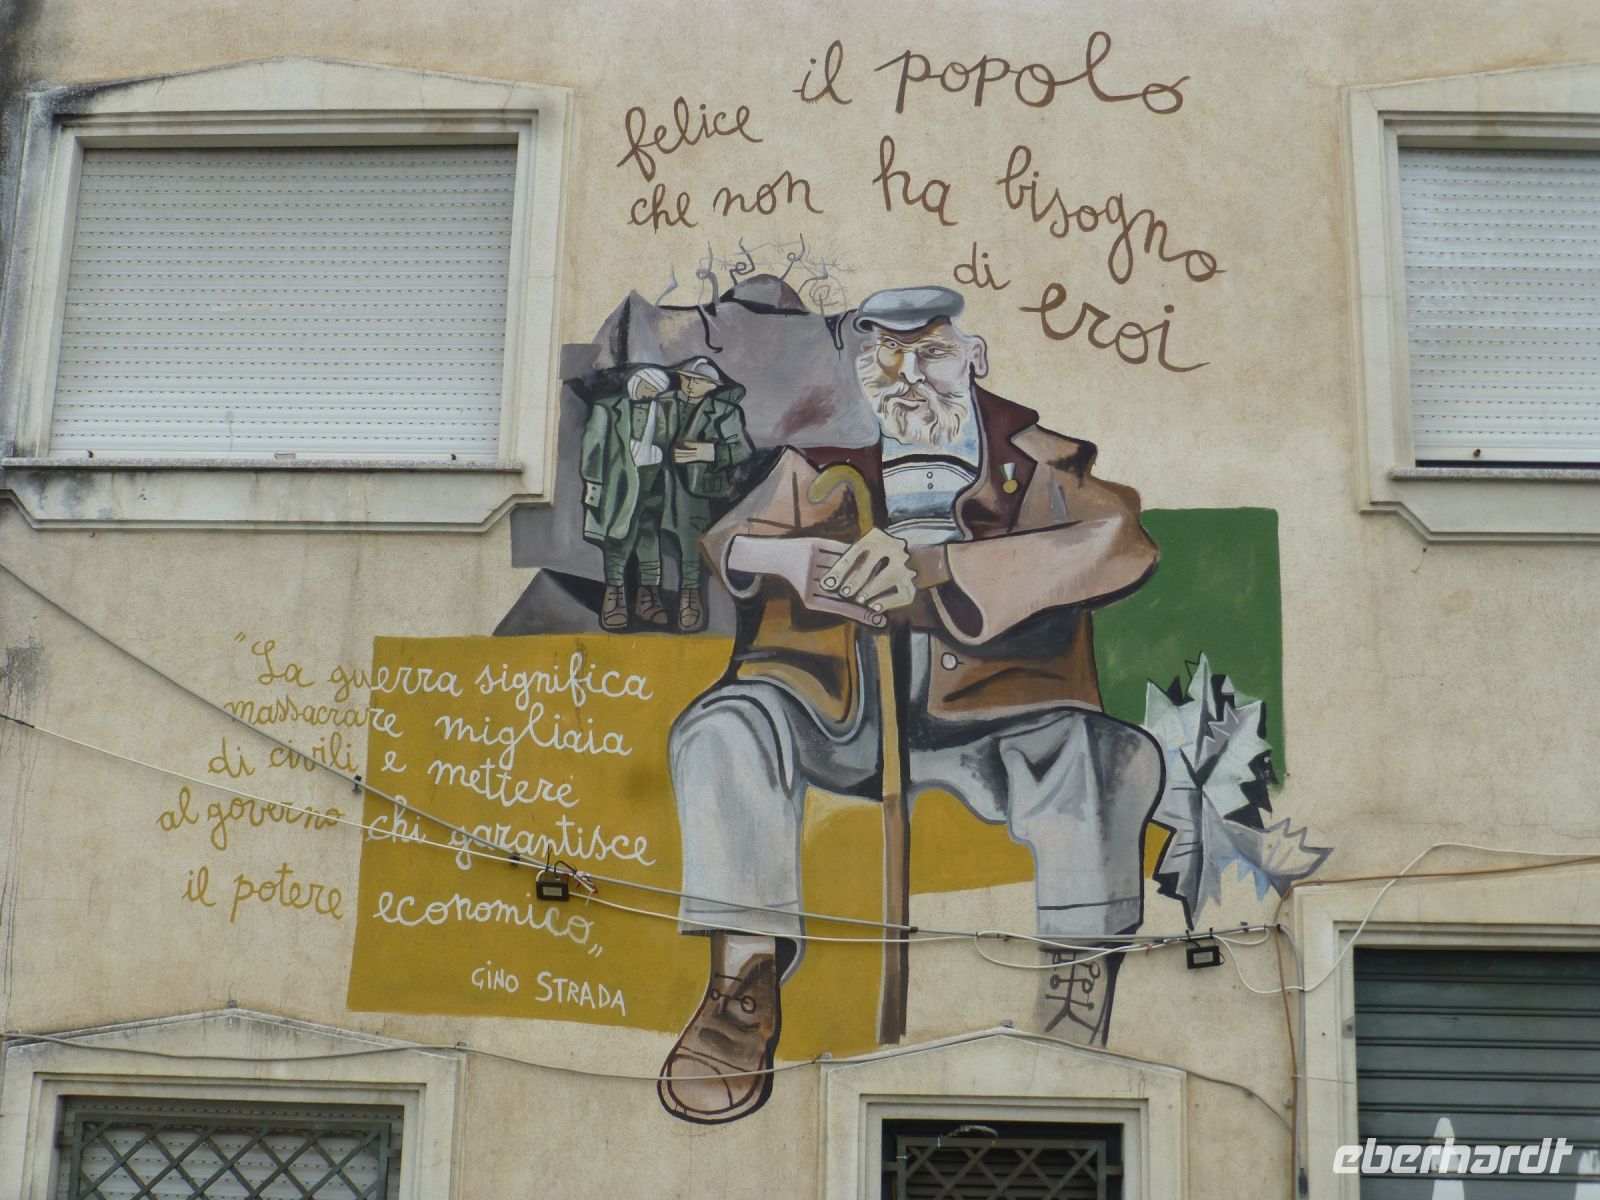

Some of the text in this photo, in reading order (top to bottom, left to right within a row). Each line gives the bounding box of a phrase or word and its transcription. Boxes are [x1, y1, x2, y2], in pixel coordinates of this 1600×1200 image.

[793, 30, 1191, 115] il popolo
[617, 96, 764, 181] felice
[627, 135, 1227, 284] che non ha bisogno
[953, 242, 1210, 373] di eroi
[327, 666, 463, 702] guerra
[475, 652, 653, 711] significa
[208, 732, 580, 807] di civili e mettere
[223, 695, 632, 771] massacrare migliaia
[156, 786, 656, 870] al governo chi garantisce
[182, 866, 217, 908] il
[230, 862, 344, 923] potere
[535, 971, 625, 1017] STRADA
